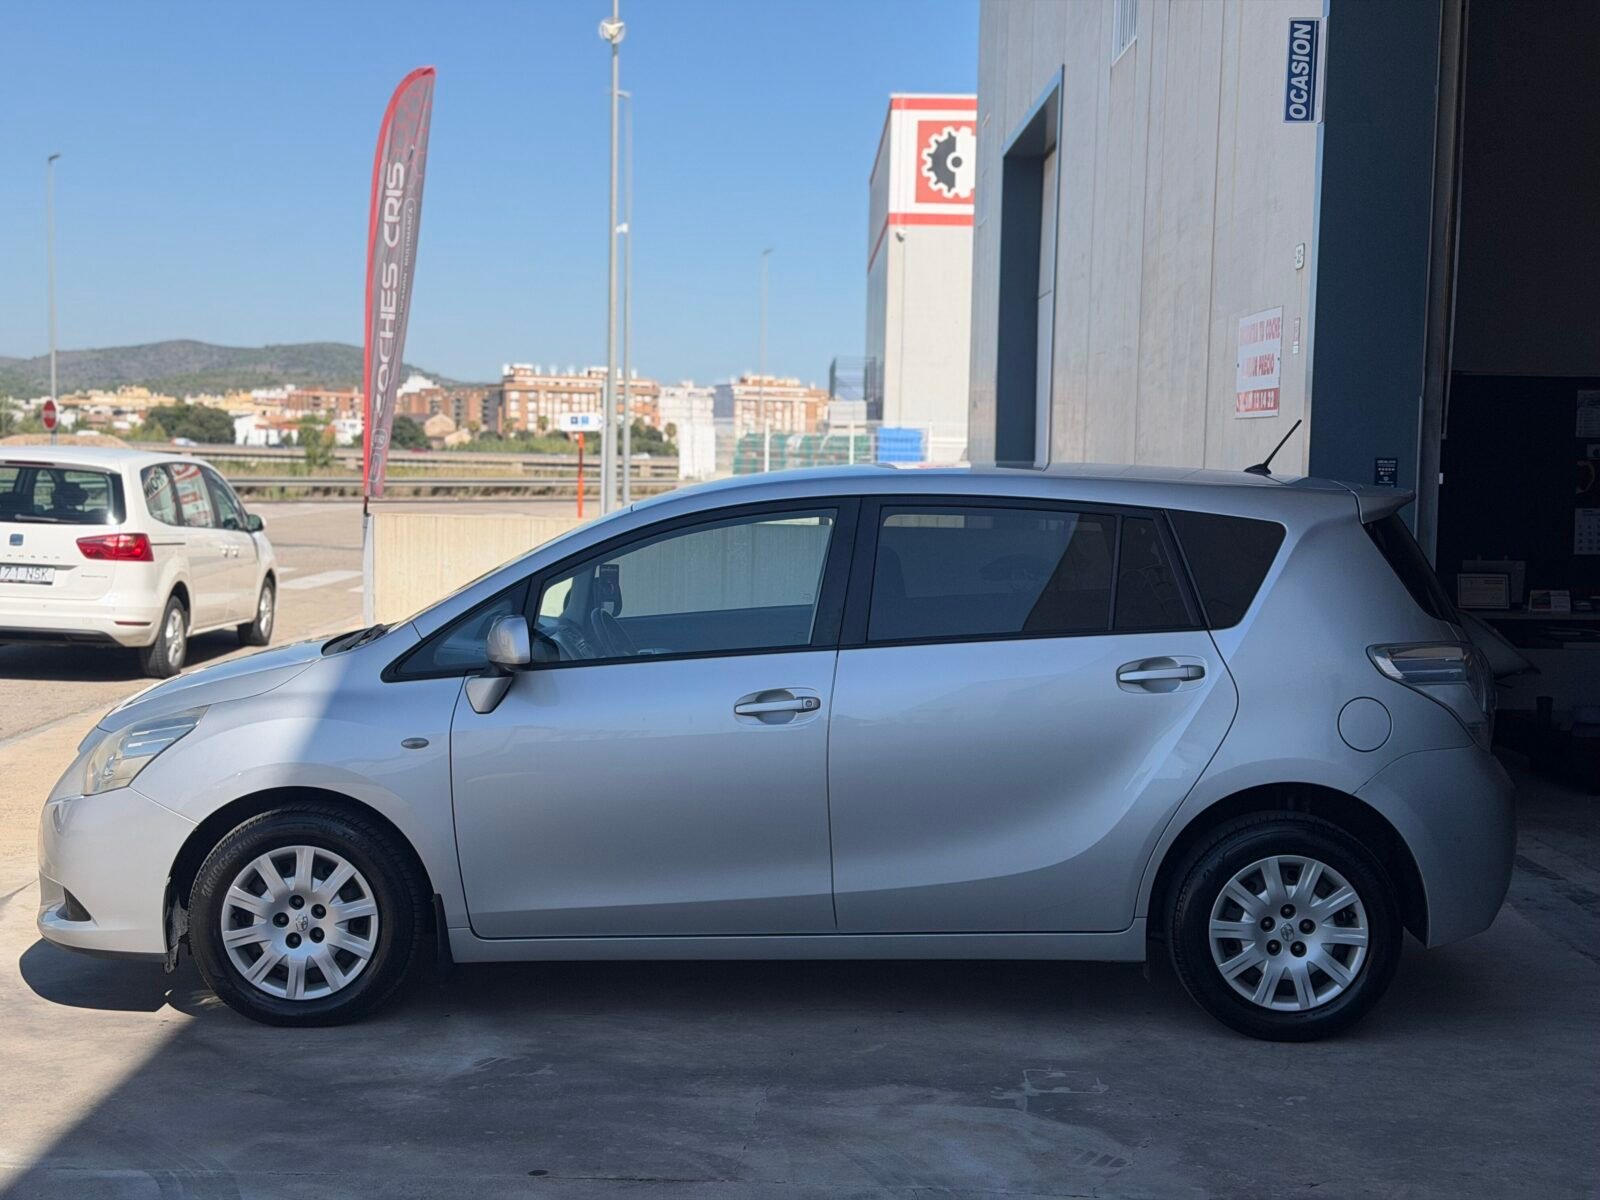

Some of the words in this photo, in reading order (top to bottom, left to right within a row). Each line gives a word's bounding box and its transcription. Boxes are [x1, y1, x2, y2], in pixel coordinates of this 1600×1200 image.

[1288, 23, 1312, 120] OCASION
[383, 162, 405, 248] CRIS
[25, 566, 49, 581] NSK
